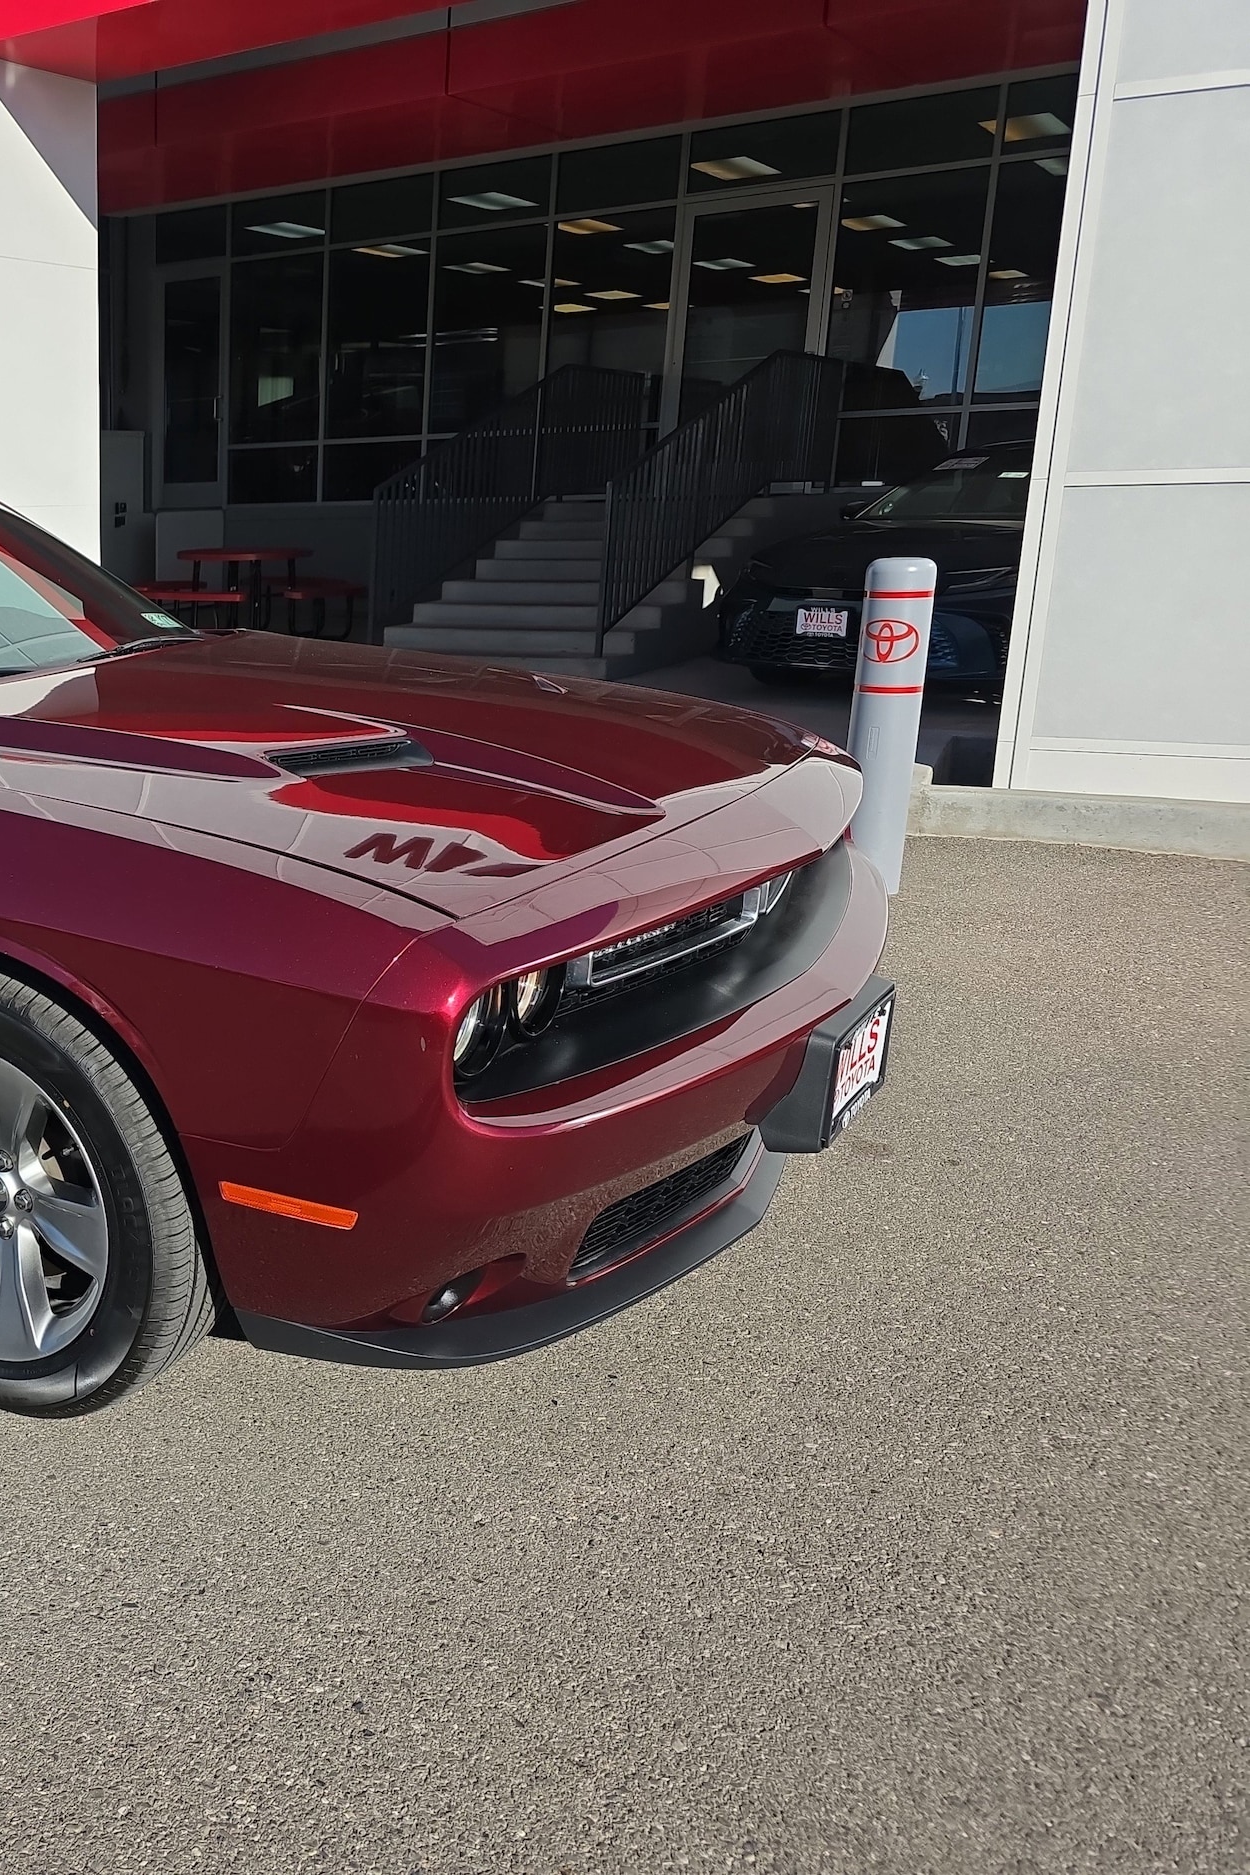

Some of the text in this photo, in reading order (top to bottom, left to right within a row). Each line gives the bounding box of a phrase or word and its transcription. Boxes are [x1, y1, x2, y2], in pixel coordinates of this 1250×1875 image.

[804, 612, 843, 625] WILLS
[812, 624, 843, 632] TOYOTA
[836, 1018, 881, 1082] WILLS
[840, 1055, 875, 1104] TOYOTA
